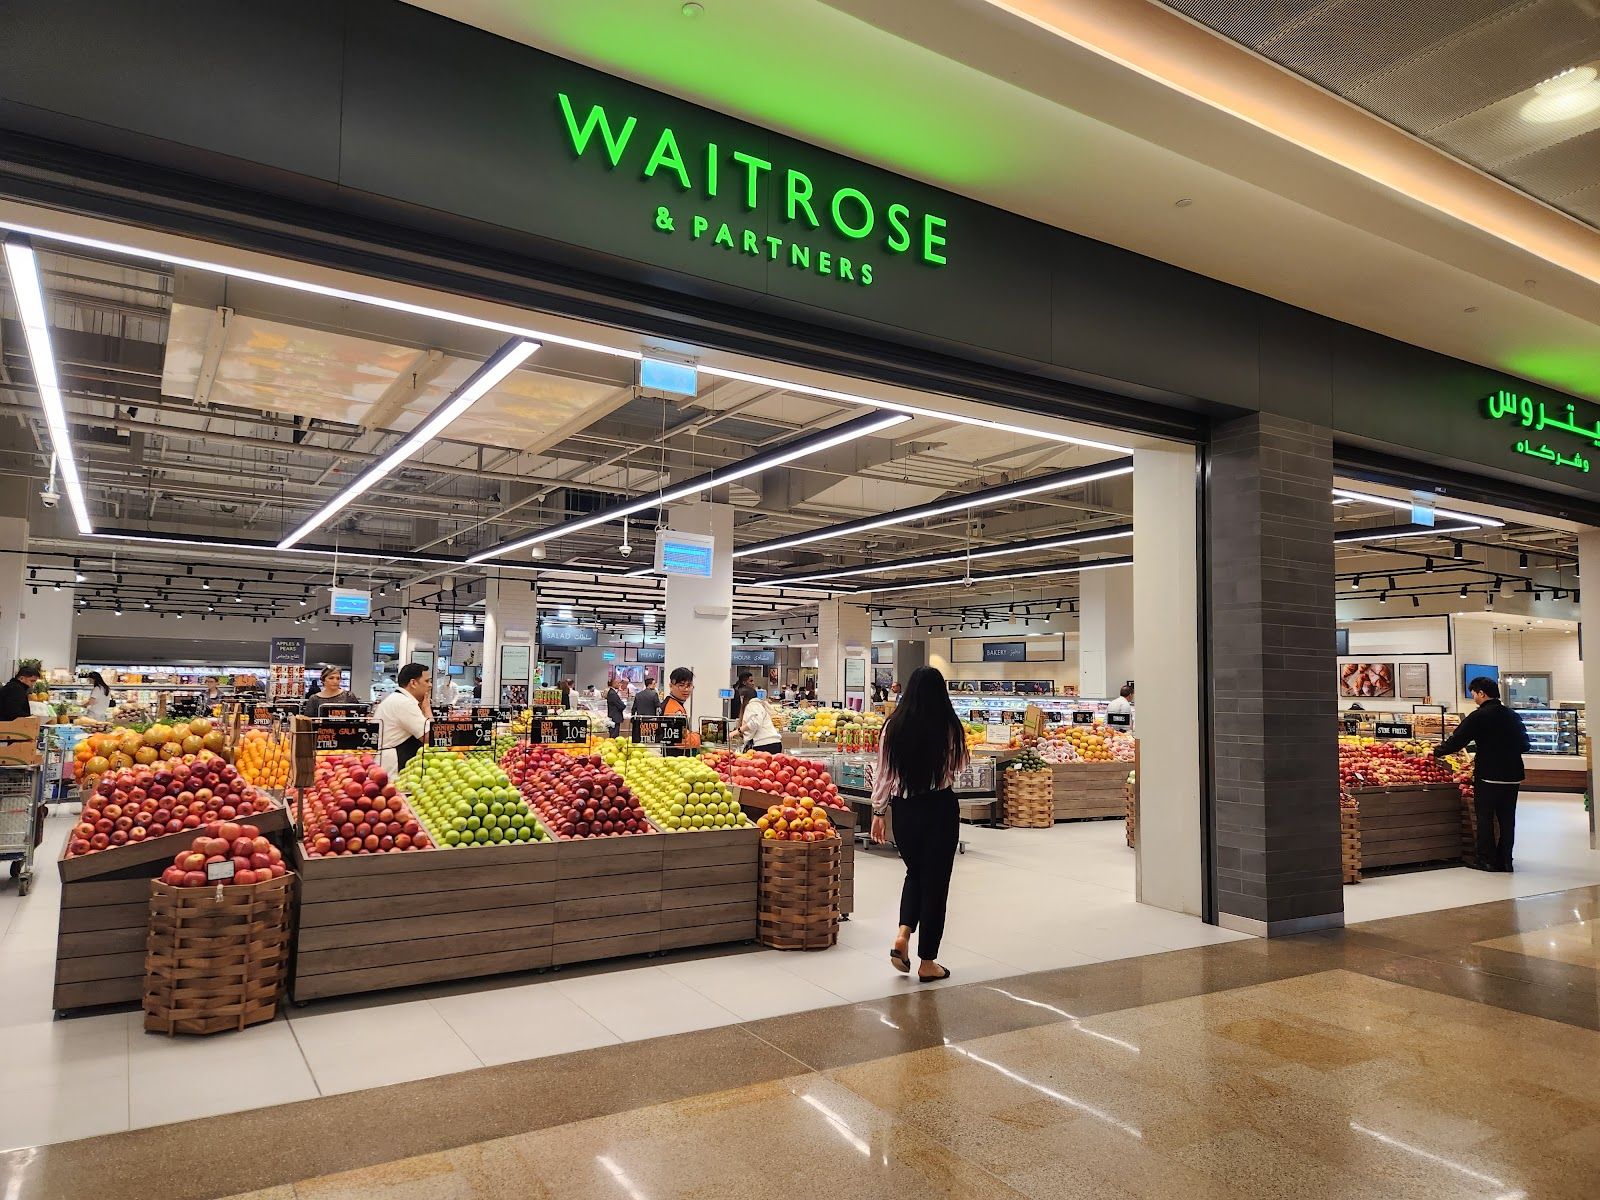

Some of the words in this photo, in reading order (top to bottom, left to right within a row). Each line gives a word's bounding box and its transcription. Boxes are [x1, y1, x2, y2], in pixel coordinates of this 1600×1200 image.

[558, 93, 948, 266] WAITROSE
[655, 206, 676, 232] &
[693, 215, 874, 286] PARTNERS
[1516, 439, 1590, 473] وشركاه
[546, 632, 571, 640] SALAD
[1392, 727, 1408, 735] FRUITS
[433, 737, 453, 747] ITALY
[541, 735, 558, 743] ITALY
[640, 735, 656, 743] ITALY
[316, 740, 338, 748] ITALY
